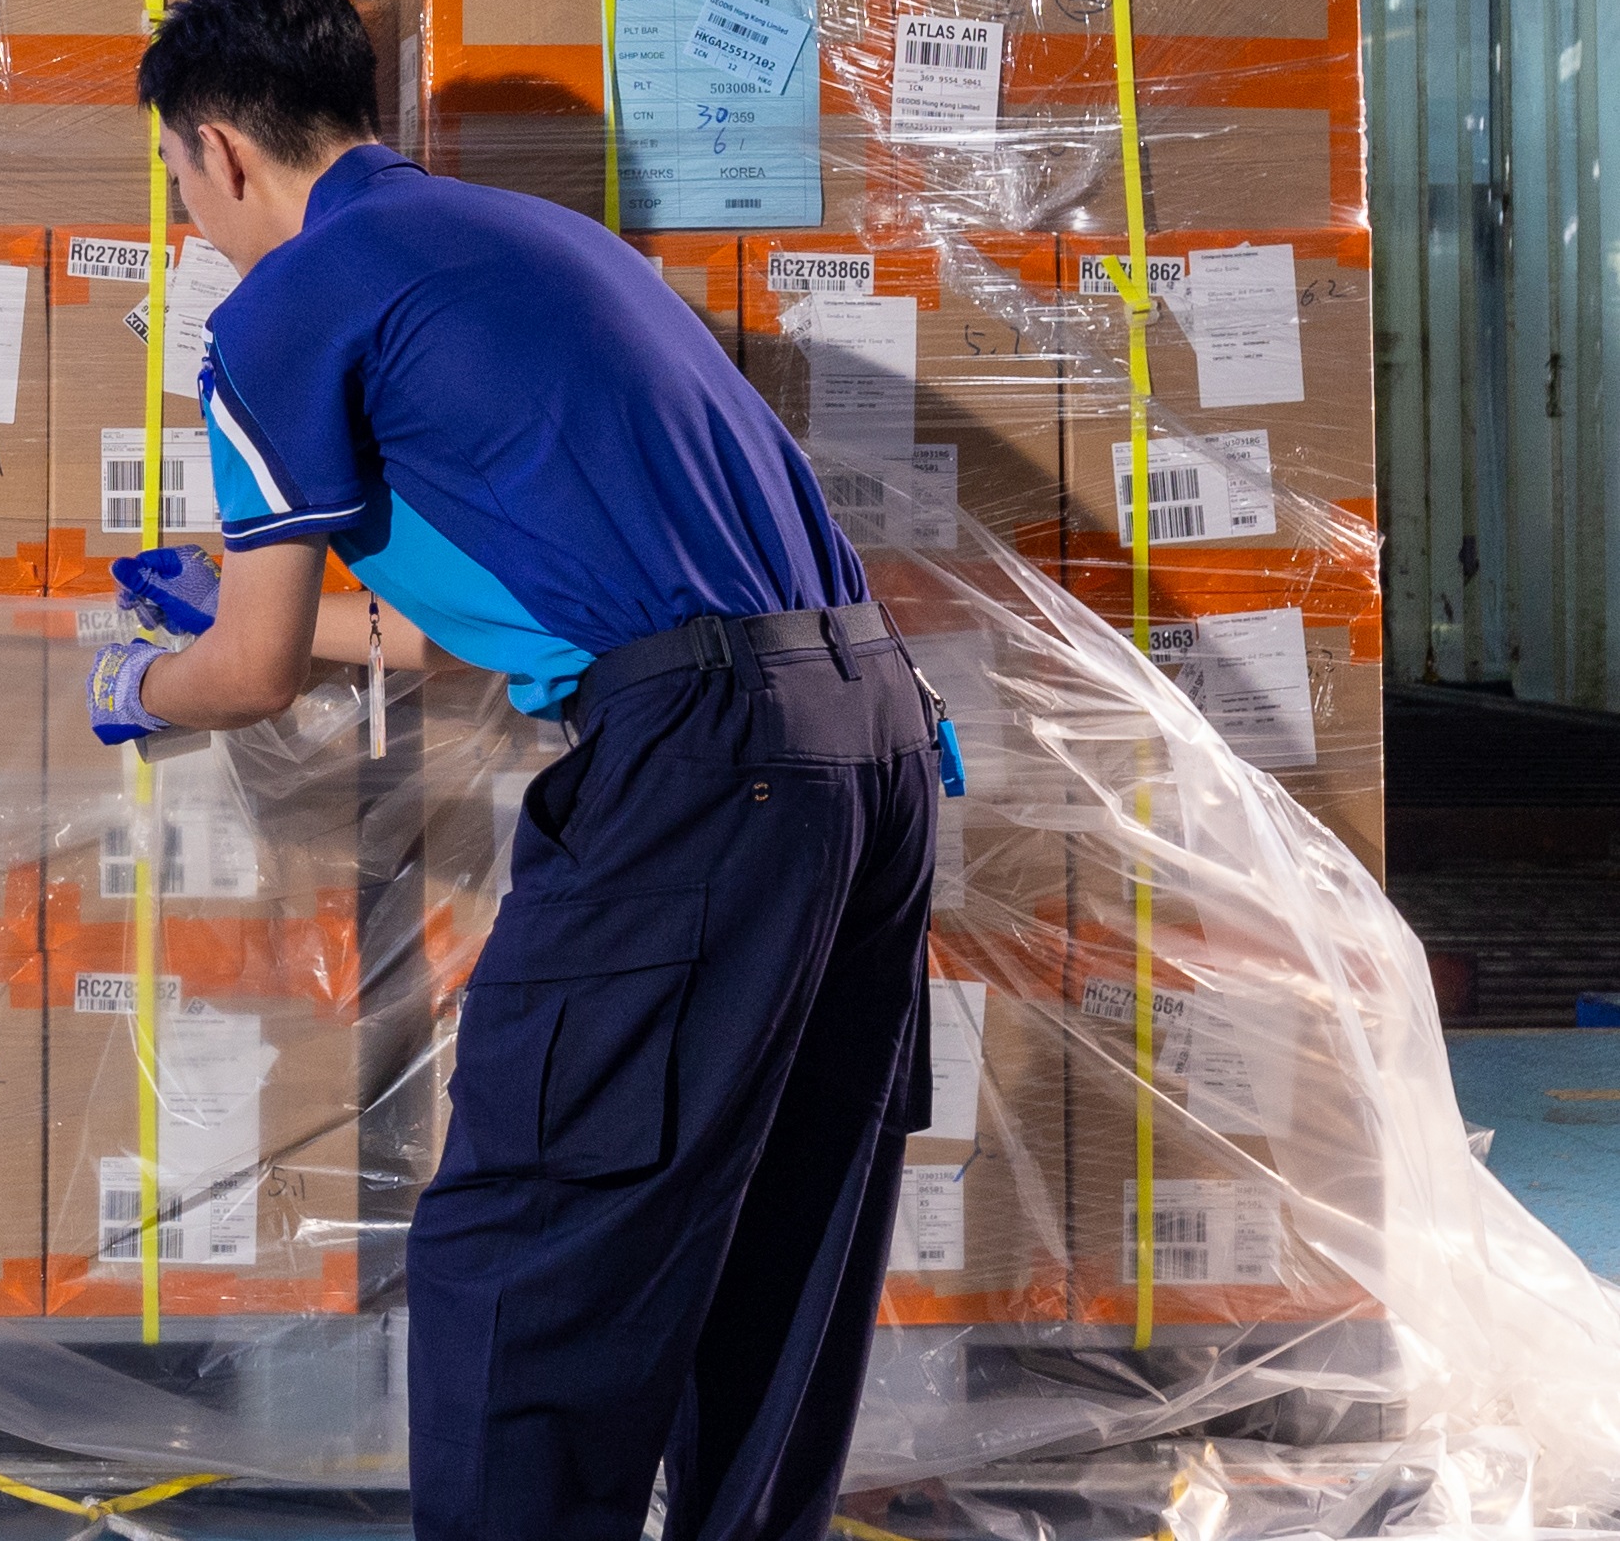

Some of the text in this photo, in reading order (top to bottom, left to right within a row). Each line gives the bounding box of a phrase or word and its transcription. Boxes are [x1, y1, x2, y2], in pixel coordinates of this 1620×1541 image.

[734, 7, 750, 20] Hong
[750, 14, 767, 27] Kong
[624, 26, 659, 35] PLT BAR
[906, 22, 988, 43] ATLAS AIR
[619, 51, 665, 60] SHIP MODE
[692, 47, 710, 59] ICN
[694, 29, 777, 72] HKGA25517102
[634, 81, 652, 90] PLT
[922, 99, 939, 109] Hong
[940, 100, 957, 111] Kong
[633, 112, 655, 121] CTN
[720, 167, 766, 179] KOREA
[628, 198, 662, 209] STOP
[770, 258, 870, 280] RC2783866
[77, 978, 178, 1000] RC27852
[1085, 984, 1185, 1017] RC27864
